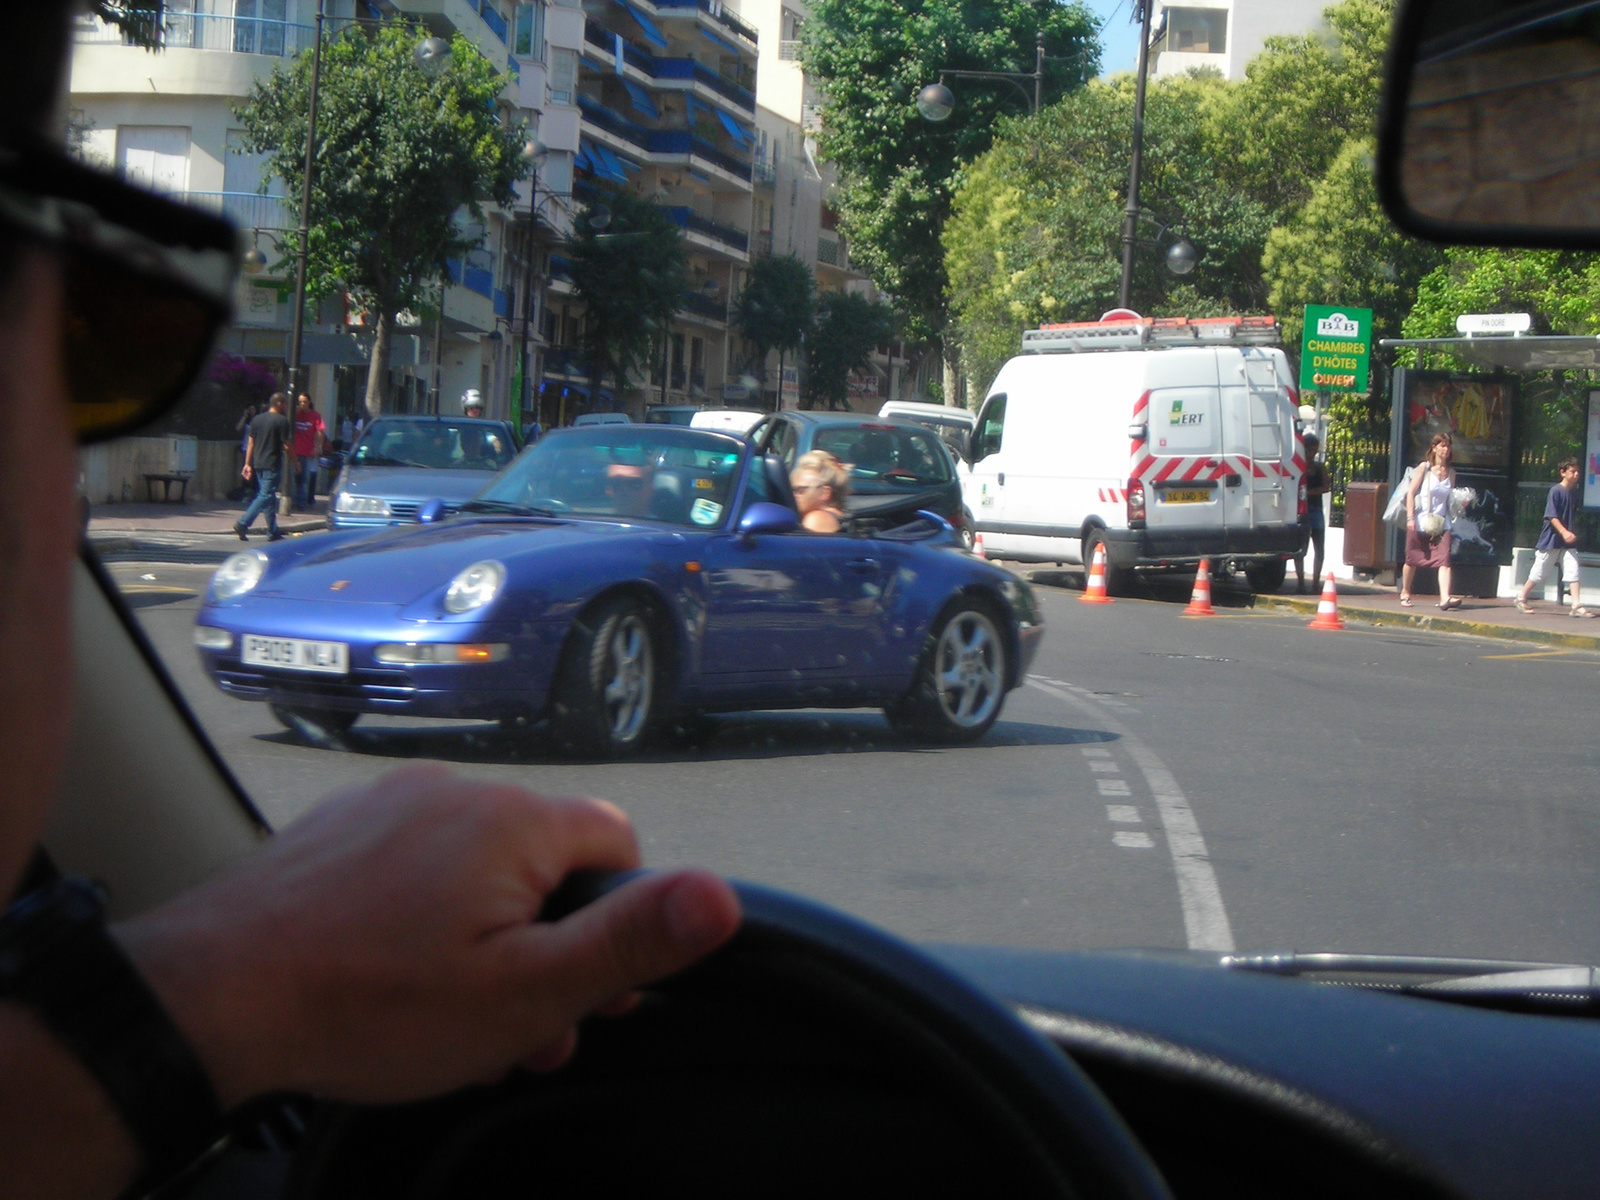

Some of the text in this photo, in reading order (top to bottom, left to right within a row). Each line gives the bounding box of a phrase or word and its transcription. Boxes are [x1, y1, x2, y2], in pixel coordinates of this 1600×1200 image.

[1481, 319, 1490, 327] PIN
[1308, 340, 1365, 354] CHAMBRES
[1313, 354, 1357, 369] D'HÔTES
